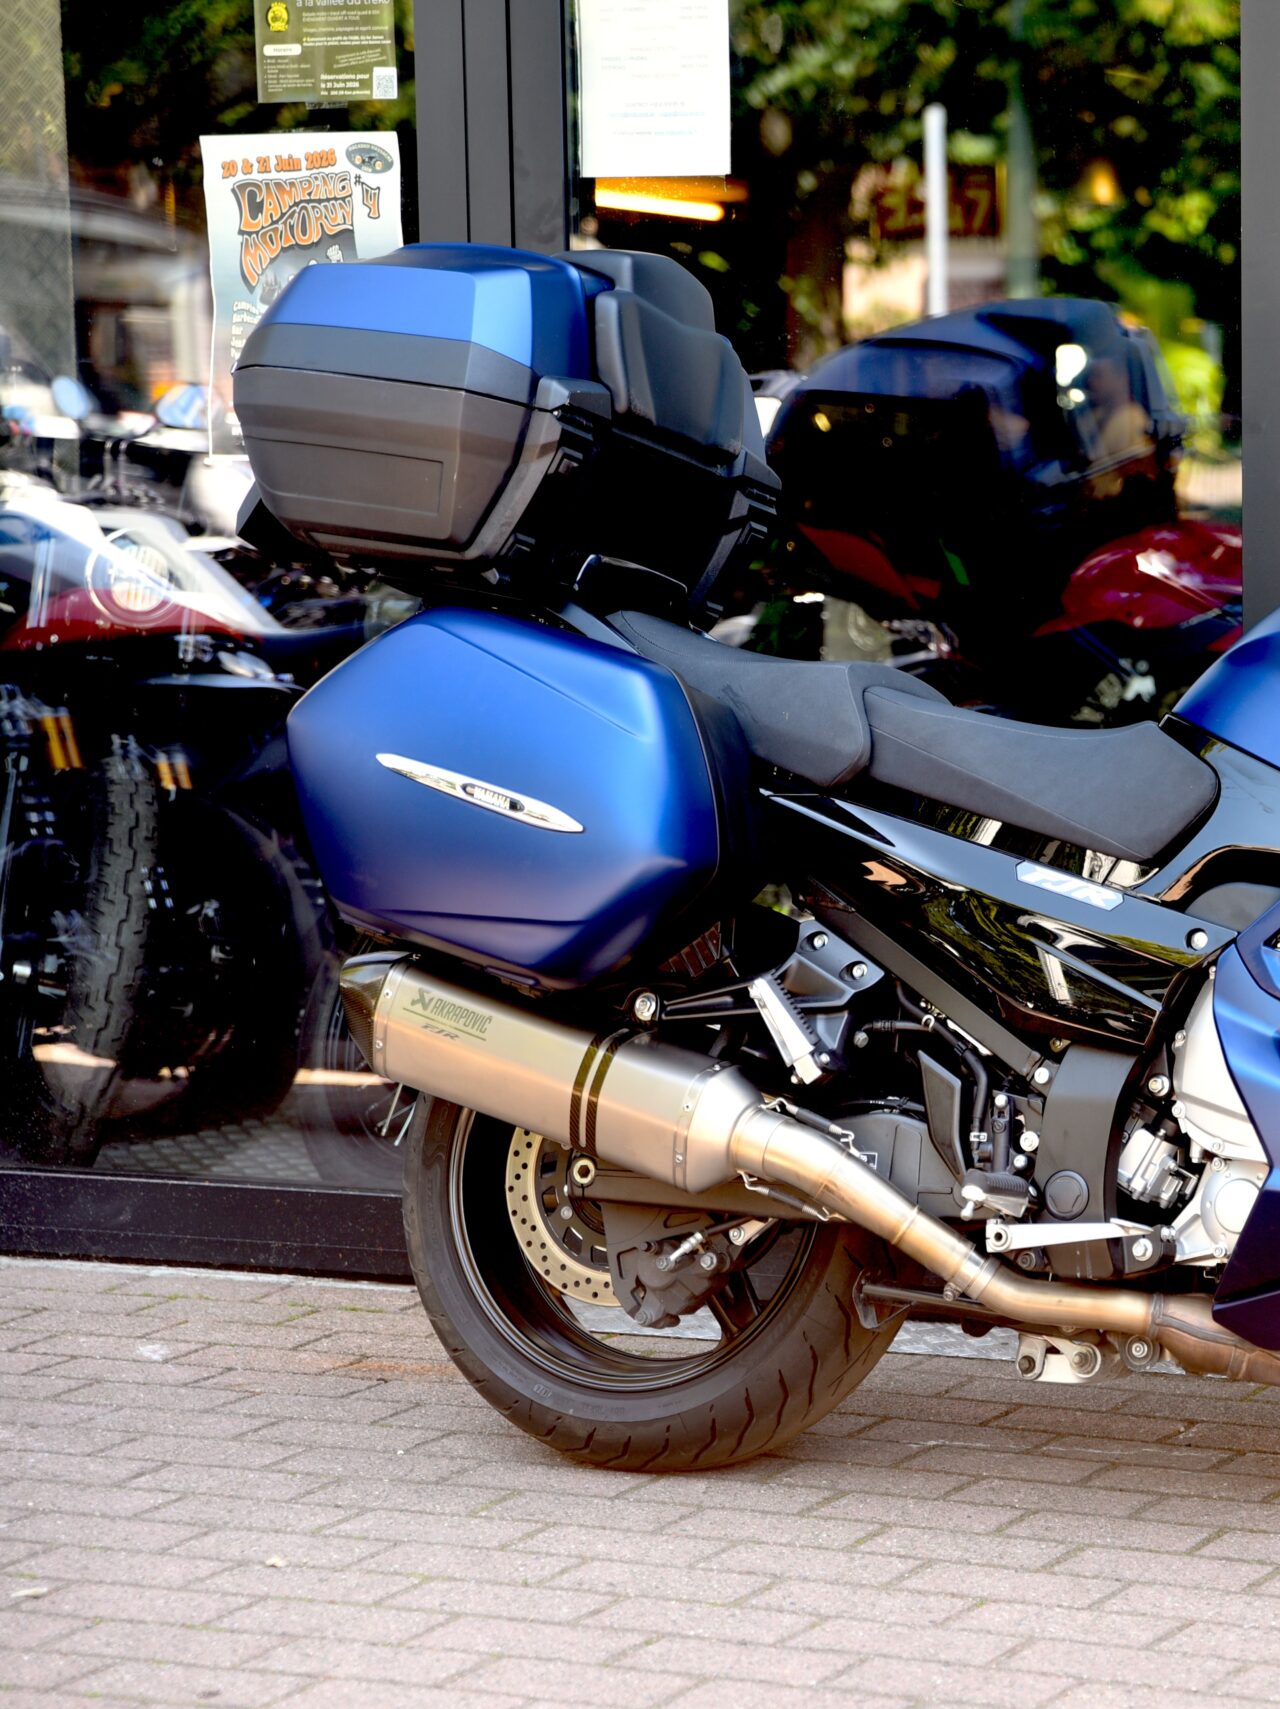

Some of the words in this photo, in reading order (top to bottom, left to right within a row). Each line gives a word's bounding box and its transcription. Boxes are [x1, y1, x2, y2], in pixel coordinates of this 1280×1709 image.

[221, 160, 238, 178] 20
[242, 158, 254, 173] &
[256, 155, 272, 173] 21
[274, 153, 302, 172] Juin
[305, 148, 337, 169] 2026
[241, 197, 353, 288] MOTORUN
